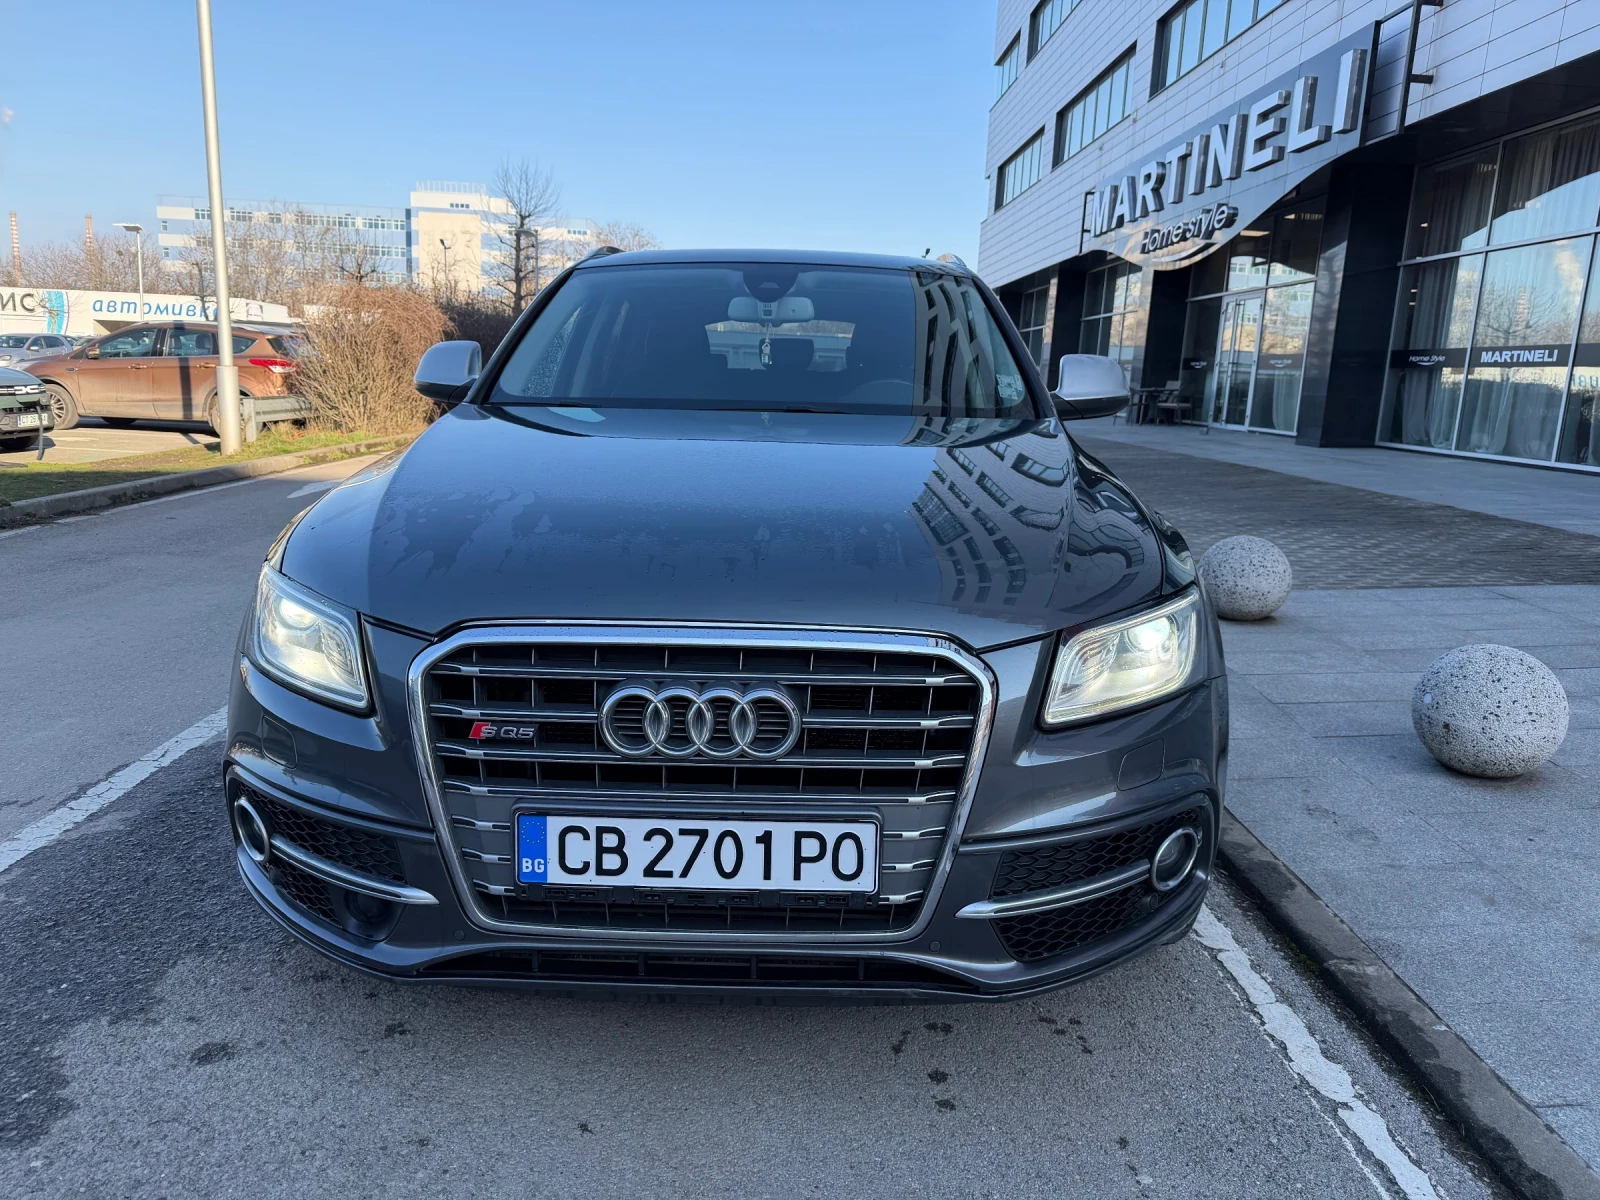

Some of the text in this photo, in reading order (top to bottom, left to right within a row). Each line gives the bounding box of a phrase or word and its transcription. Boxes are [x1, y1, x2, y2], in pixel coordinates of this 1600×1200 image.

[1090, 49, 1368, 238] MARTINELI
[1141, 222, 1185, 253] Home
[1480, 349, 1558, 363] MARTINELI
[480, 725, 534, 738] SQ5
[557, 824, 629, 876] CB
[642, 827, 773, 881] 2701
[522, 857, 545, 873] BG
